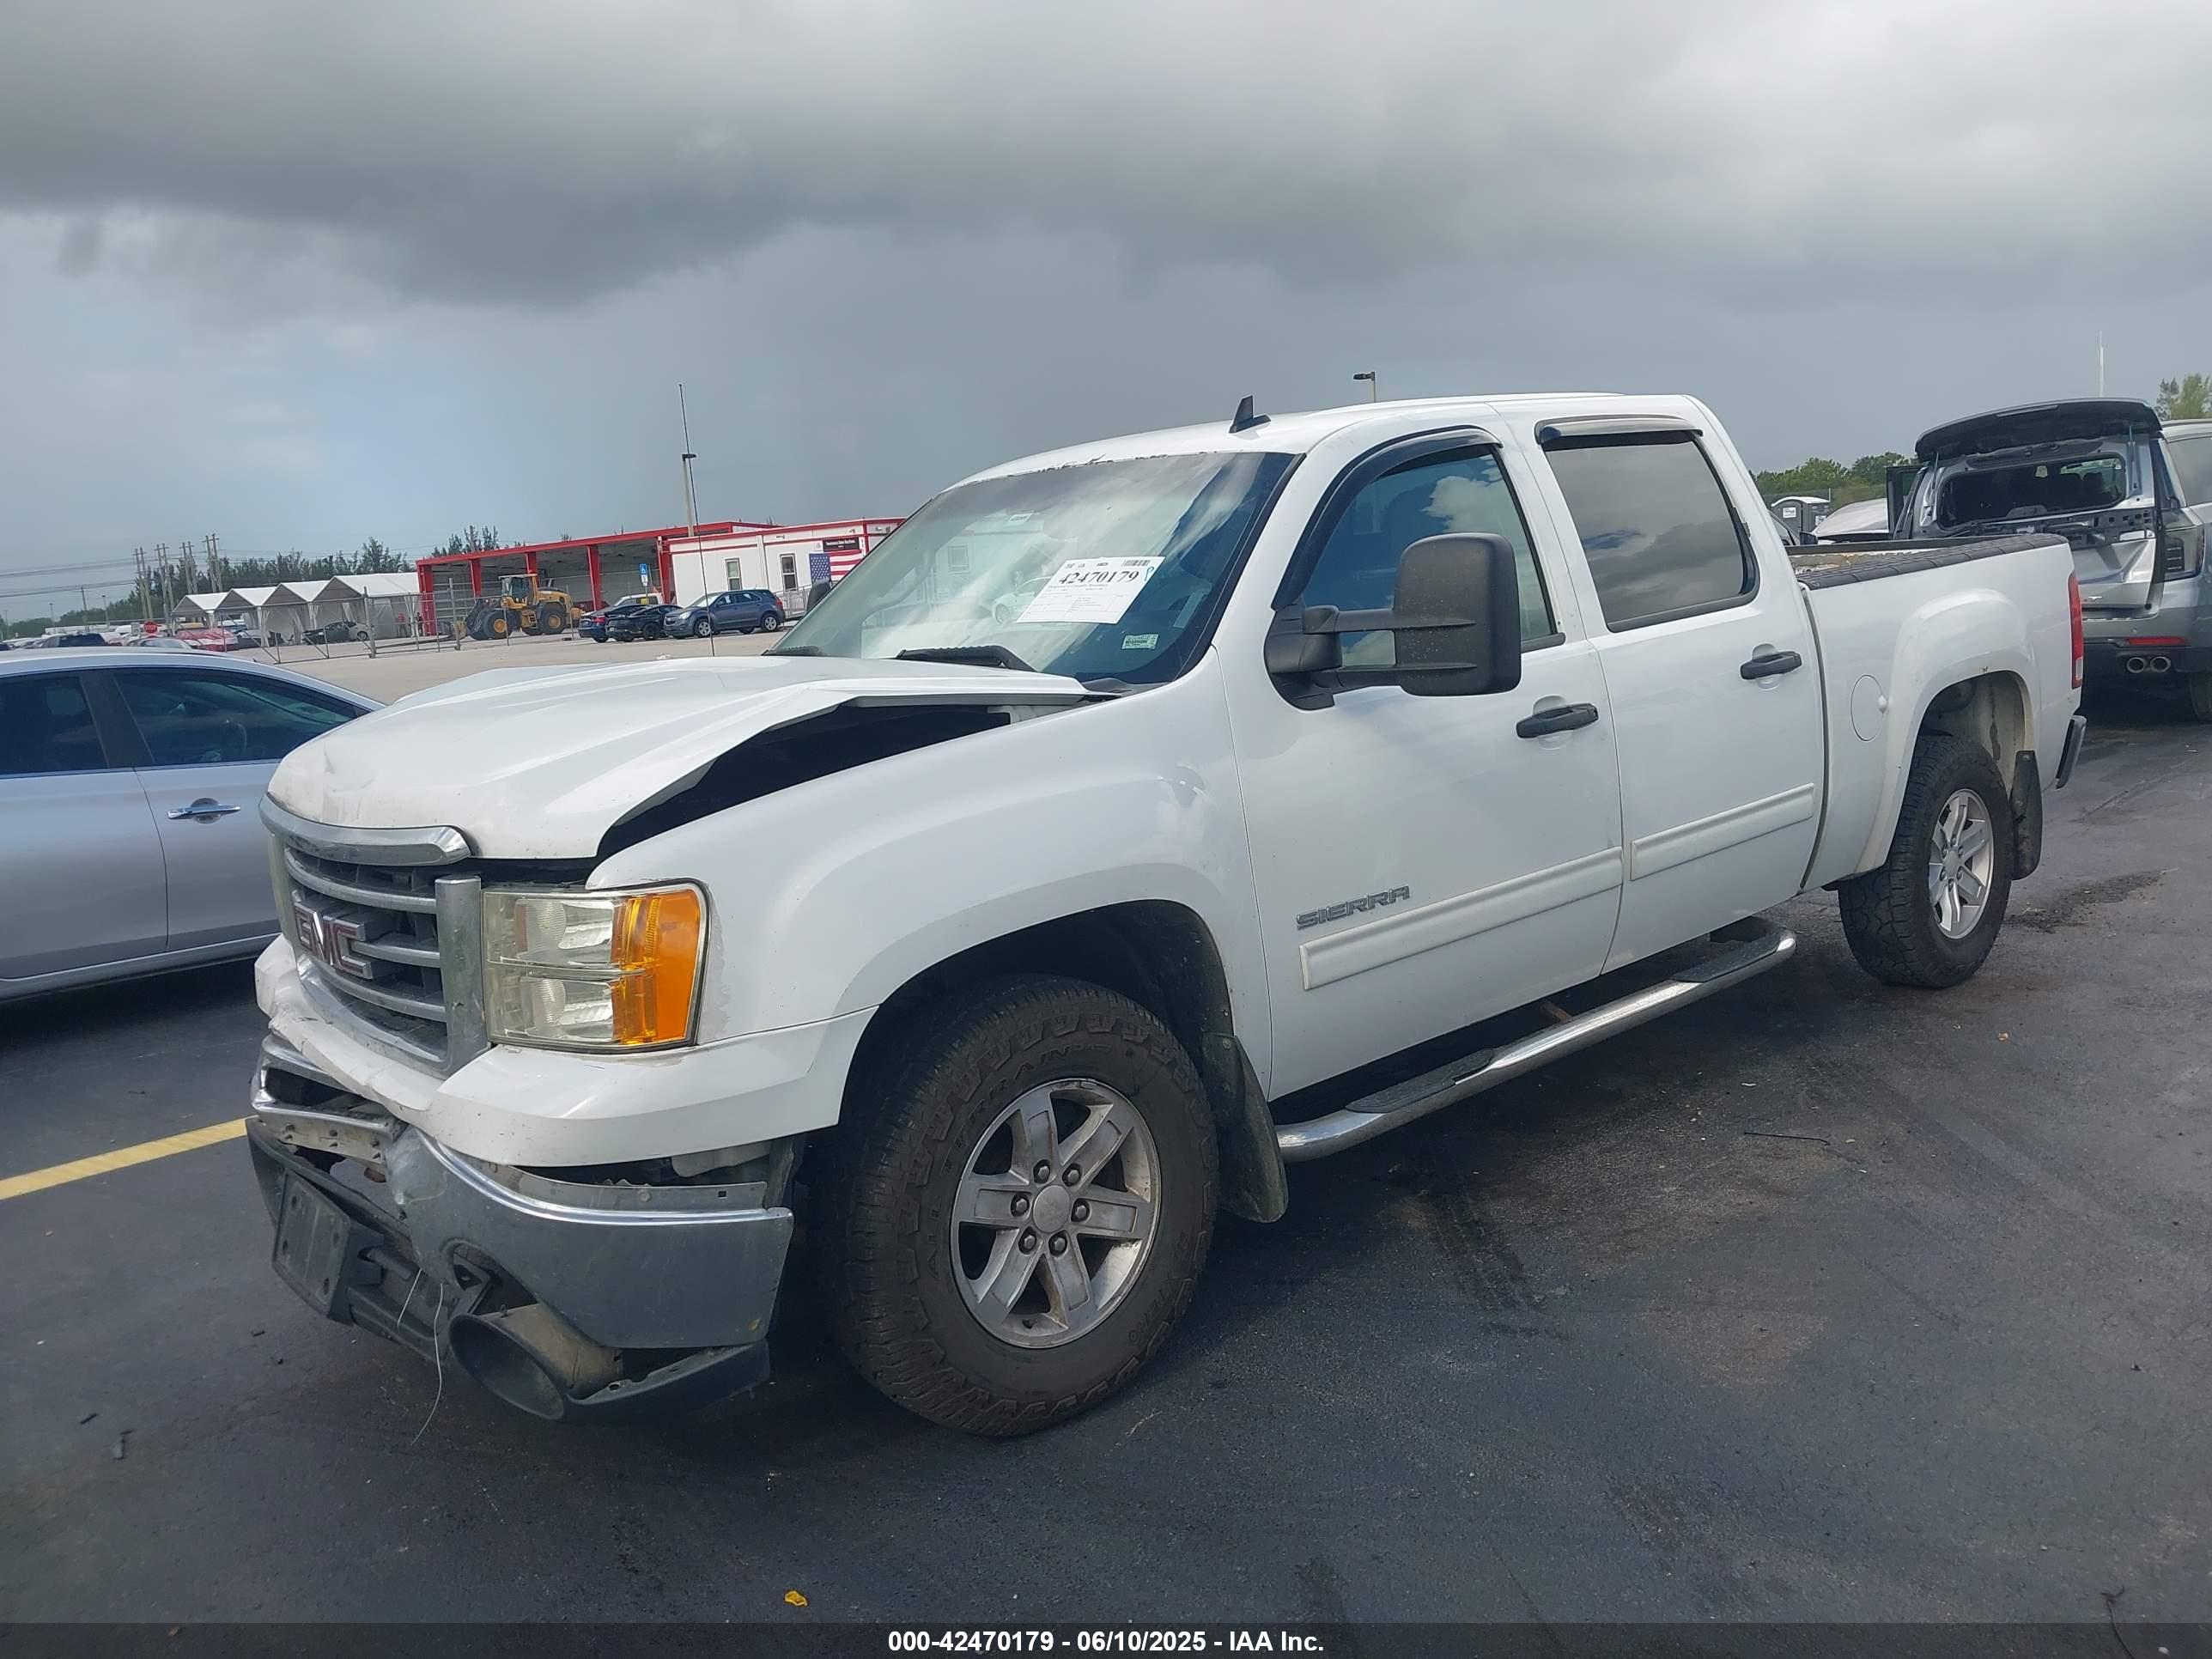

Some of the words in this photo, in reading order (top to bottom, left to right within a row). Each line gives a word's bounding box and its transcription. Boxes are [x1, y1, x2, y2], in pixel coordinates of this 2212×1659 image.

[1059, 570, 1139, 585] 42470179
[1296, 884, 1410, 930] SIERRA
[295, 902, 374, 979] GMC
